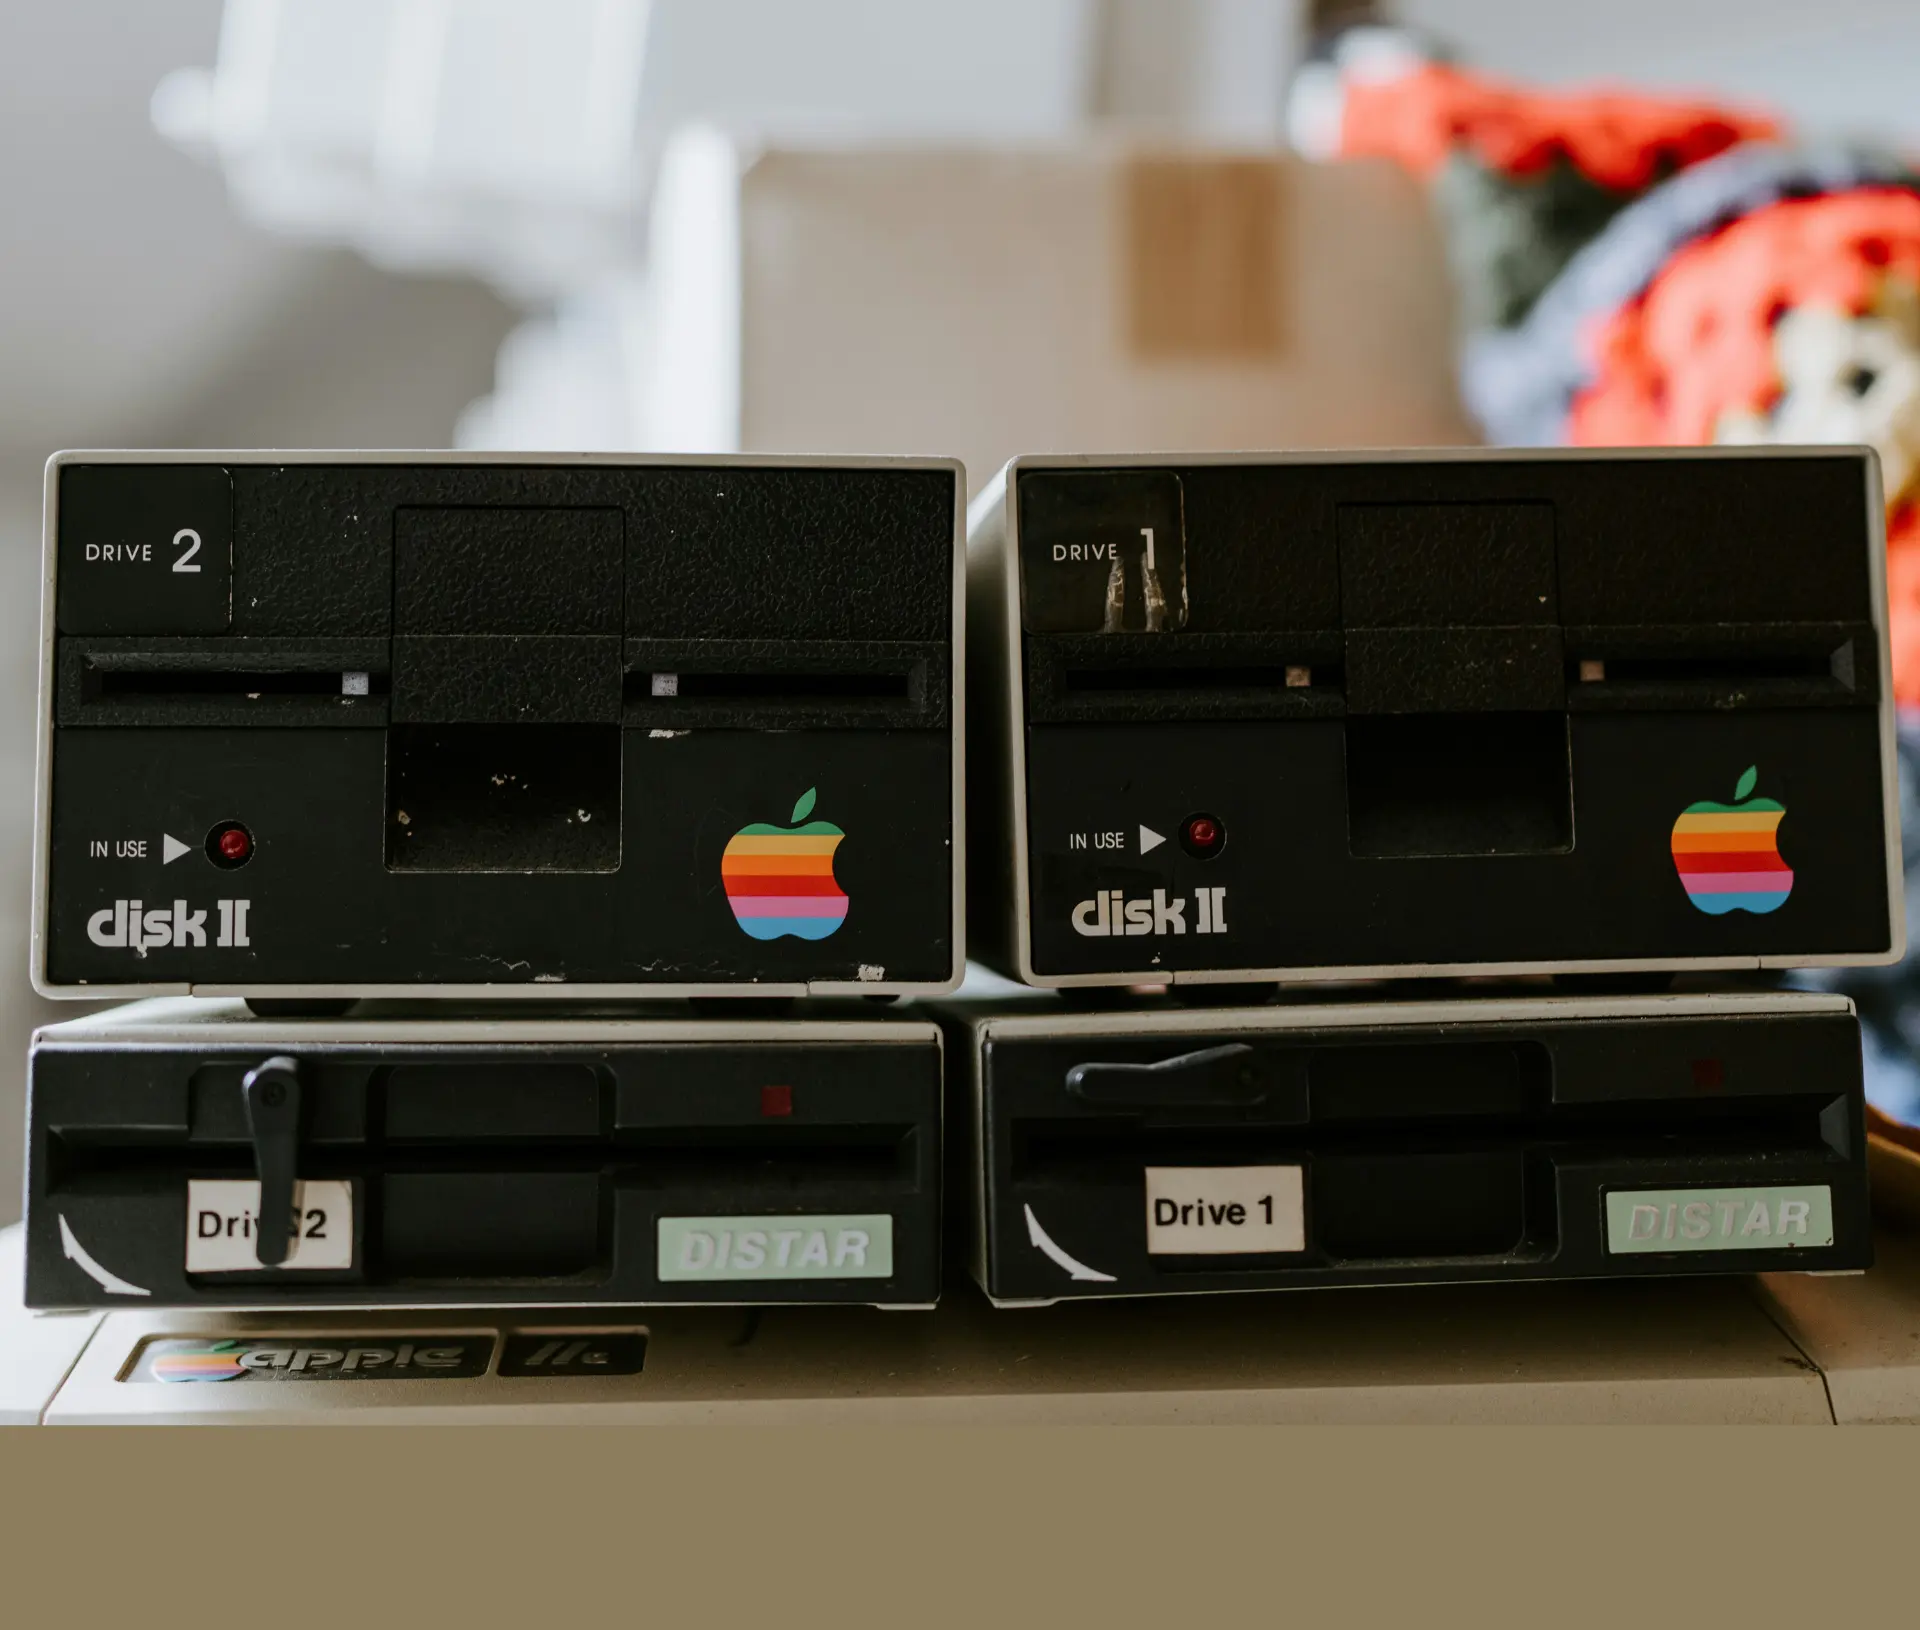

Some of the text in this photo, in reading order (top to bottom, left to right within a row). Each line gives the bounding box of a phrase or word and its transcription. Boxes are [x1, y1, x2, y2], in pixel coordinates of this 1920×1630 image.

[85, 528, 202, 573] DRIVE 2
[1053, 527, 1155, 570] DRIVE 1
[90, 840, 147, 858] IN USE
[1070, 832, 1124, 849] IN USE
[87, 899, 251, 947] disk II
[1071, 887, 1228, 937] disk II
[198, 1208, 327, 1239] Dri 2
[1154, 1195, 1273, 1227] Drive 1
[1629, 1199, 1811, 1240] DISTAR
[679, 1229, 870, 1271] DISTAR
[238, 1344, 465, 1373] apple
